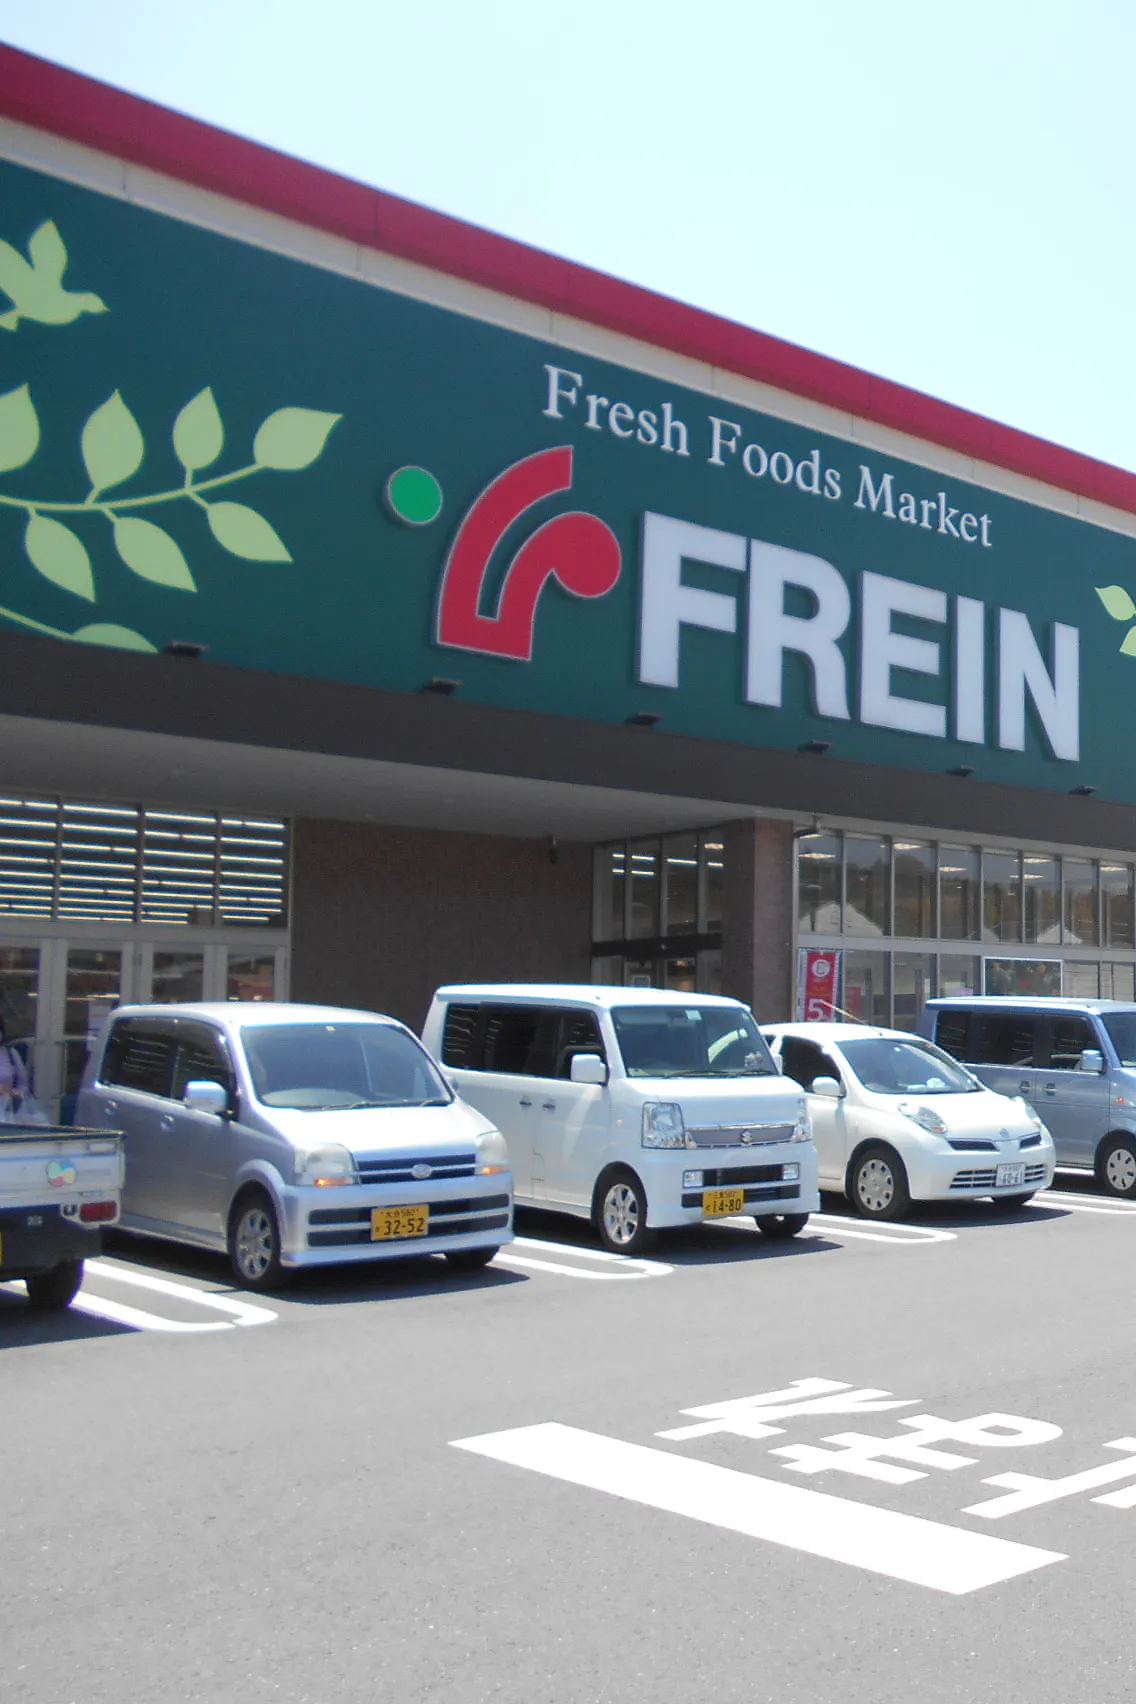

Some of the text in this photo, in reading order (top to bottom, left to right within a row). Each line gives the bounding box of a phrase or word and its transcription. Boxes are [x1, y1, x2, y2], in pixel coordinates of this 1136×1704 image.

[542, 363, 993, 548] Fresh Foods Market
[636, 510, 1080, 762] FREIN
[383, 1217, 425, 1236] 32-52
[713, 1198, 742, 1214] 14-80
